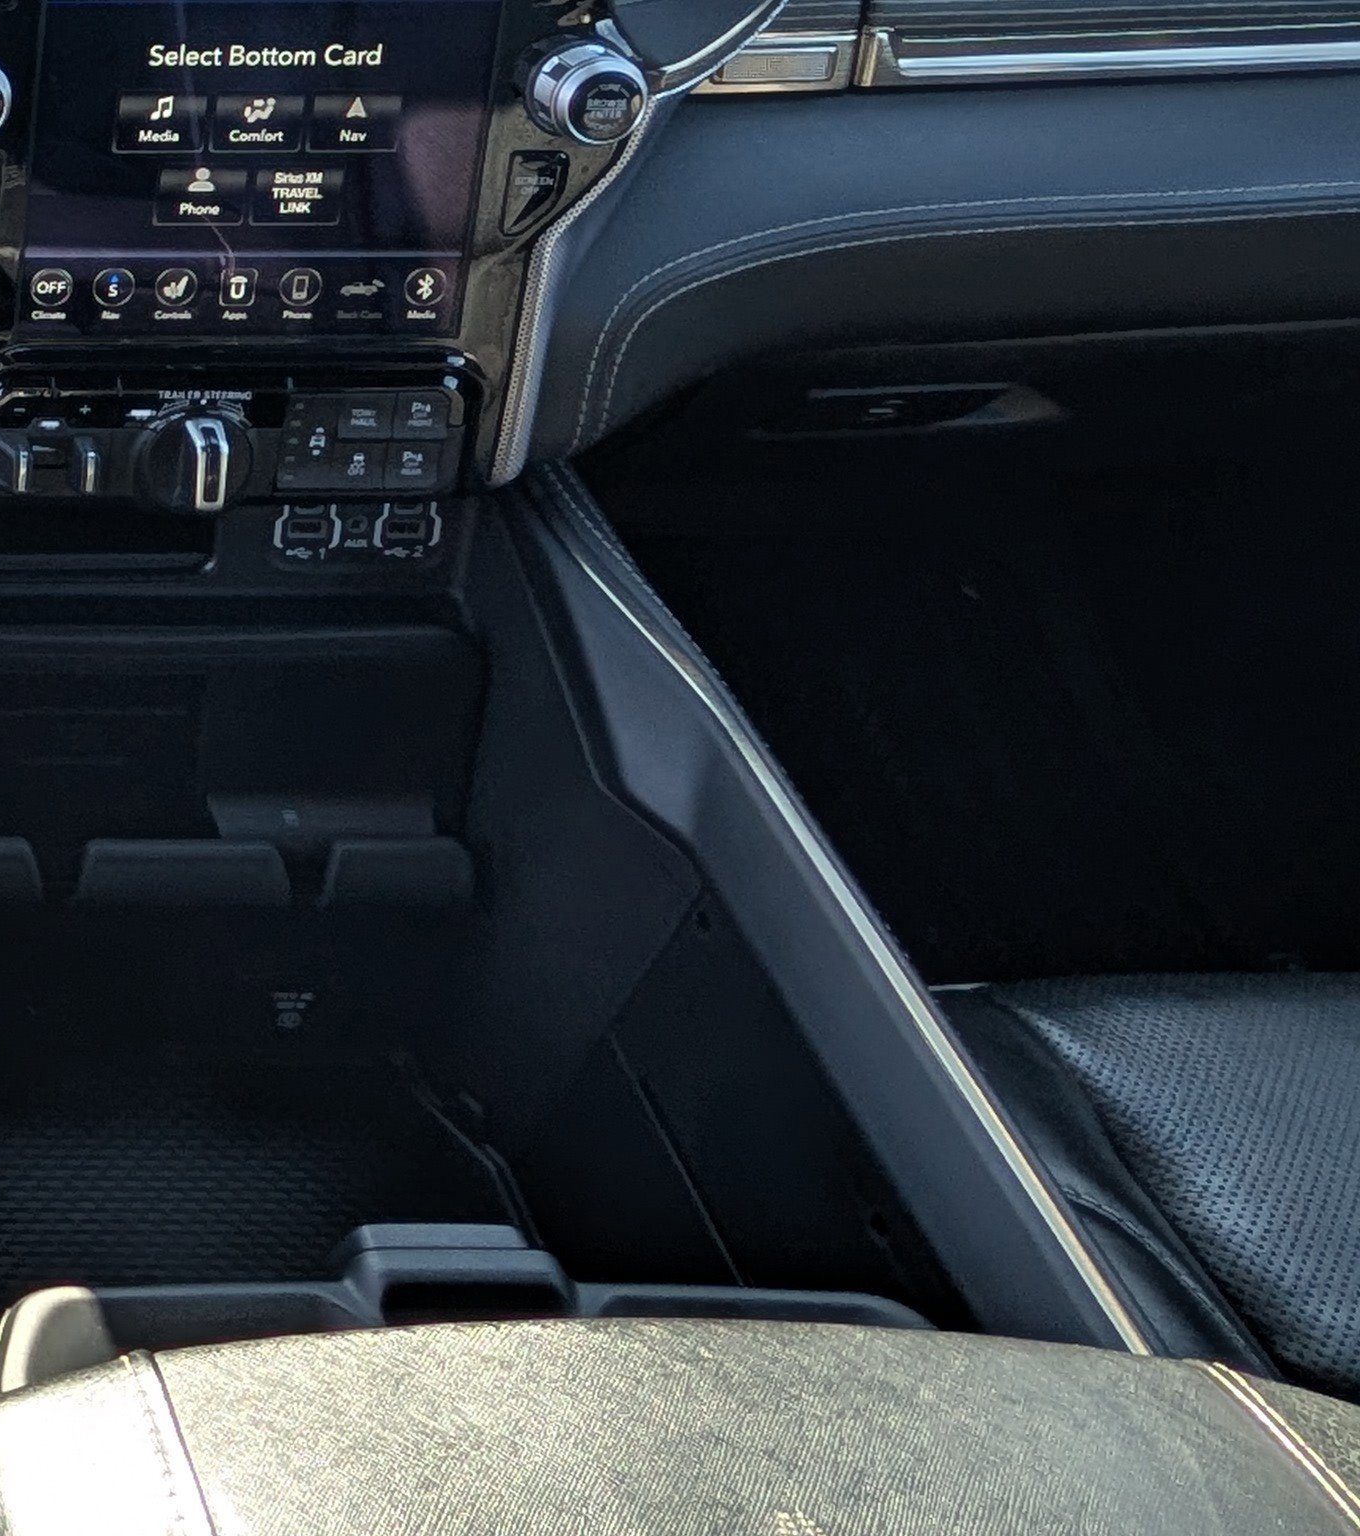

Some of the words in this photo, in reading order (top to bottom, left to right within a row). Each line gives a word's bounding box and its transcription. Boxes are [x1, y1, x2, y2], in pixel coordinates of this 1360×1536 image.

[149, 43, 223, 66] Select
[229, 45, 316, 66] Bottom
[324, 43, 383, 66] Card
[138, 130, 180, 142] Media
[229, 129, 284, 142] Comfort
[339, 130, 367, 142] Nav
[274, 172, 304, 184] Sirius
[305, 172, 323, 184] XM
[272, 187, 323, 199] TRAVEL
[179, 203, 220, 215] Phone
[279, 201, 311, 214] LINK
[36, 280, 67, 294] OFF
[108, 284, 119, 298] S
[31, 310, 67, 320] Climate
[101, 310, 120, 320] Nav
[222, 310, 248, 321] Apps
[282, 310, 312, 320] Phone
[406, 310, 436, 320] Media
[410, 545, 424, 558] 2
